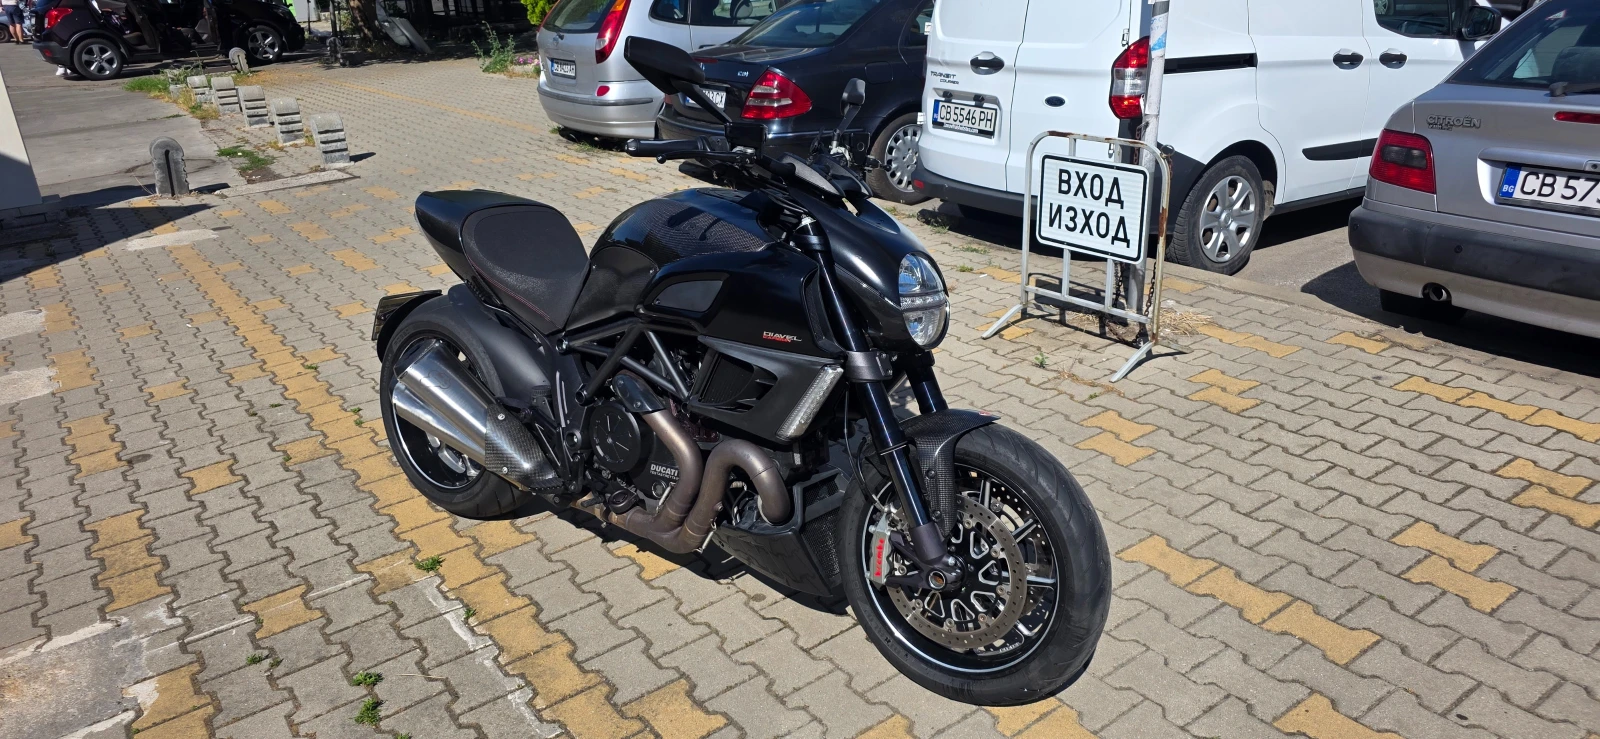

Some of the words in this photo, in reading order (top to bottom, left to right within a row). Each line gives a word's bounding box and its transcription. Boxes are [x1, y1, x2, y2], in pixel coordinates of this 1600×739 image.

[930, 71, 956, 79] TRANSIT
[940, 104, 951, 121] CB
[953, 106, 976, 125] 5546
[978, 110, 993, 128] PH
[1427, 113, 1481, 129] CITROËN
[1058, 168, 1124, 209] ВХОД
[1502, 184, 1515, 193] BG
[1520, 171, 1557, 198] CB
[1560, 175, 1600, 204] 57
[1049, 202, 1130, 248] ИЗХОД
[763, 331, 802, 342] DIAVEL
[650, 463, 678, 477] DUCATI
[874, 539, 884, 576] brembo
